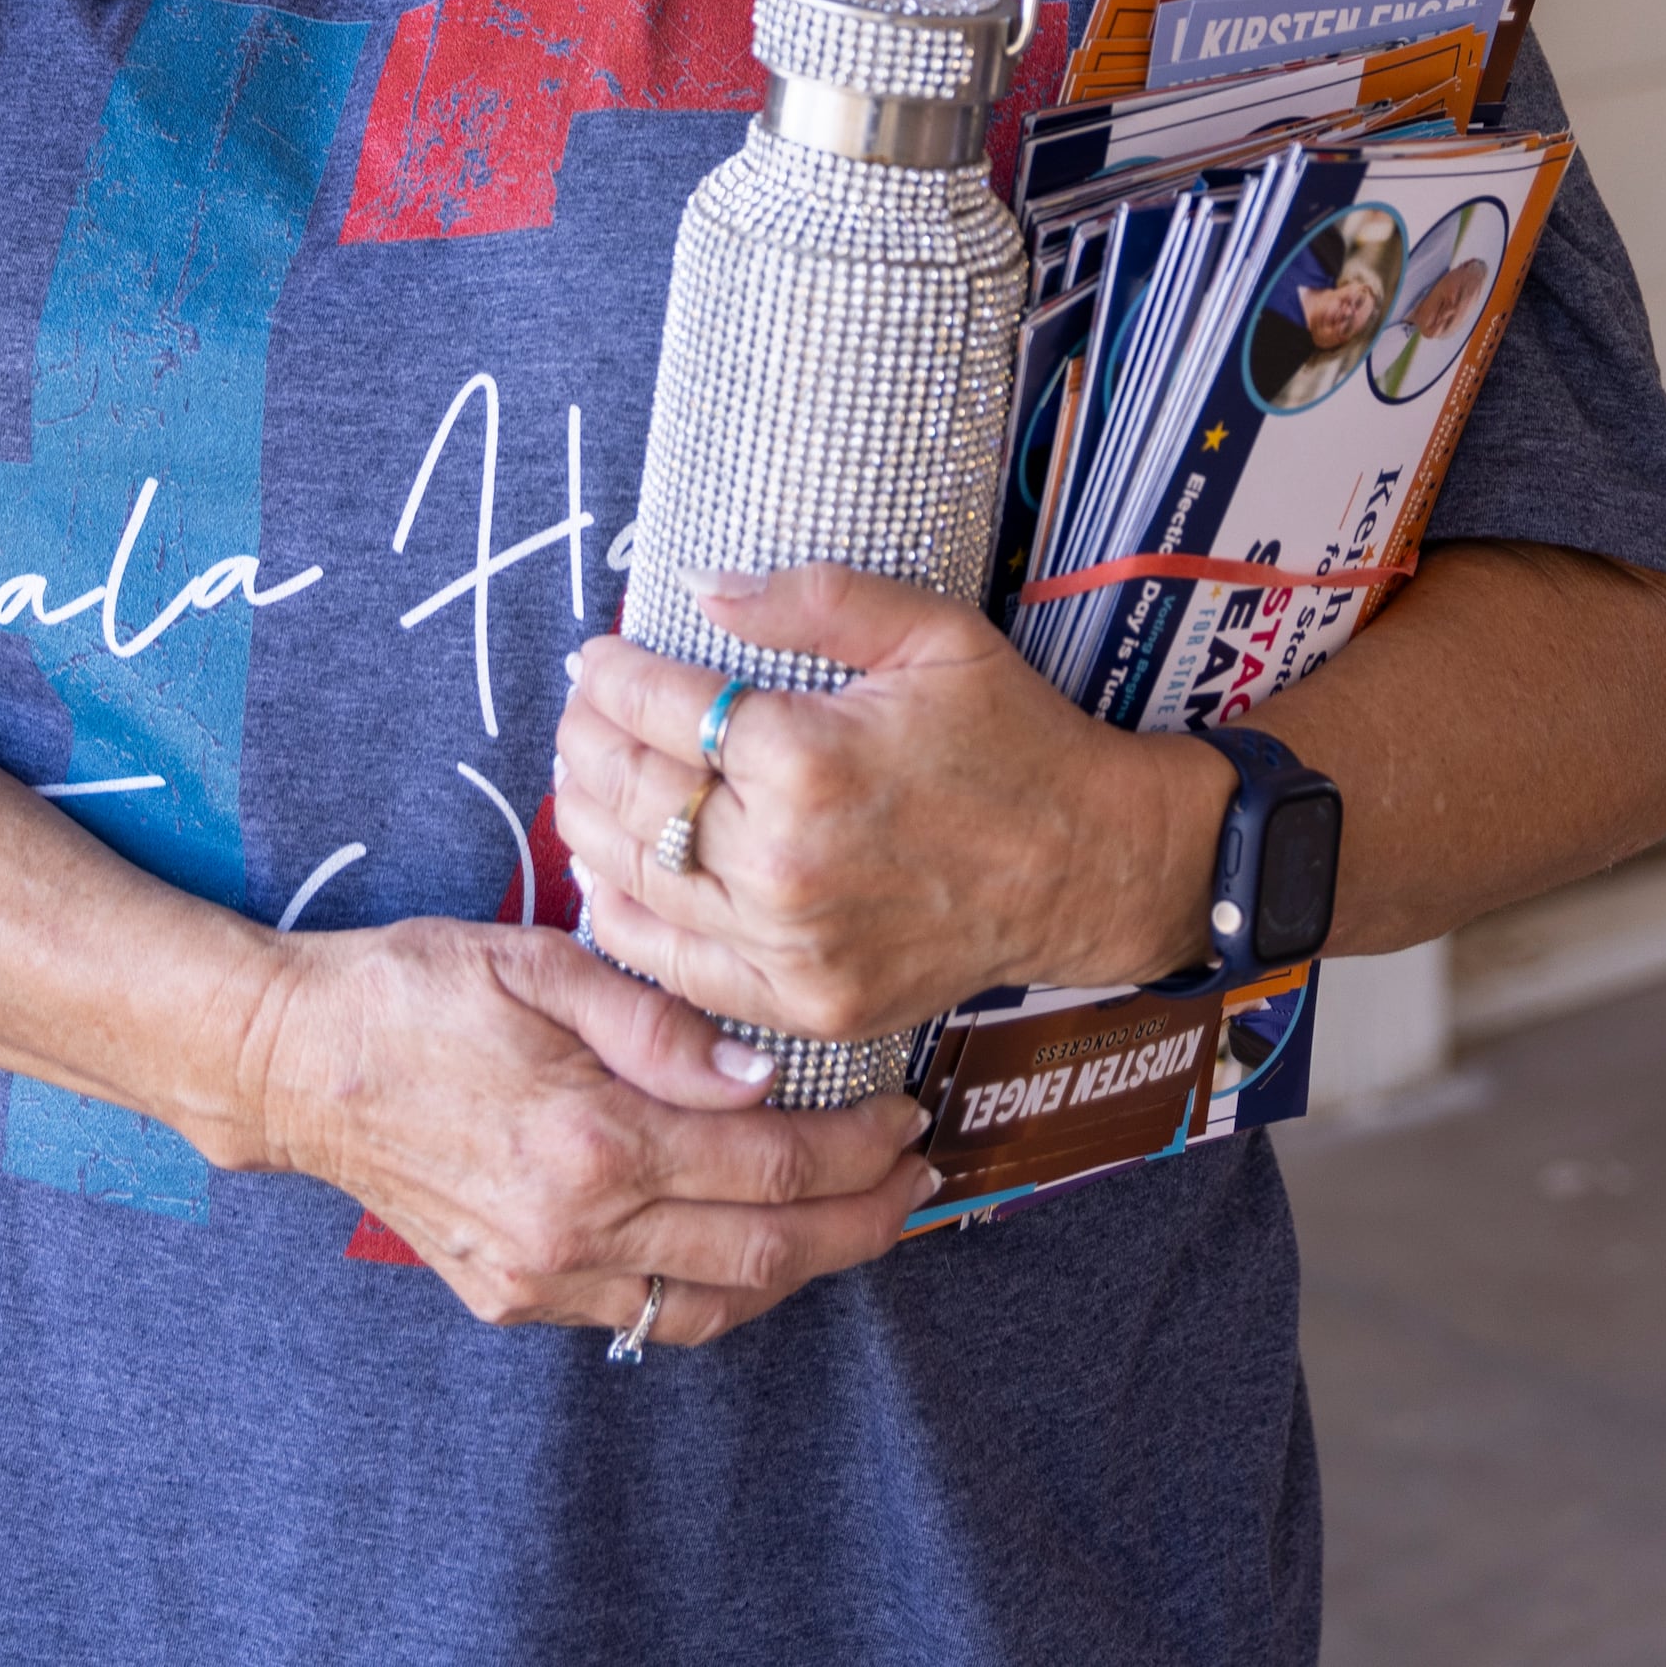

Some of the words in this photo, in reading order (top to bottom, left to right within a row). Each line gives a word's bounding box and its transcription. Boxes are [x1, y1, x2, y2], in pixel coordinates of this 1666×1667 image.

[1158, 471, 1207, 556] Electio
[1317, 463, 1404, 632] Keih
[1126, 579, 1162, 634] Day
[1141, 593, 1177, 655] Voting
[1183, 538, 1282, 732] SEAM
[1185, 607, 1217, 647] FOR
[1117, 636, 1139, 662] is
[1218, 586, 1294, 724] STAC
[1115, 658, 1151, 722] Begins
[1157, 654, 1197, 716] STATE
[1035, 1026, 1130, 1065] CONGRESS
[1135, 1015, 1168, 1040] FOR
[1069, 1025, 1205, 1107] KIRSTEN
[959, 1065, 1073, 1133] ENGEL
